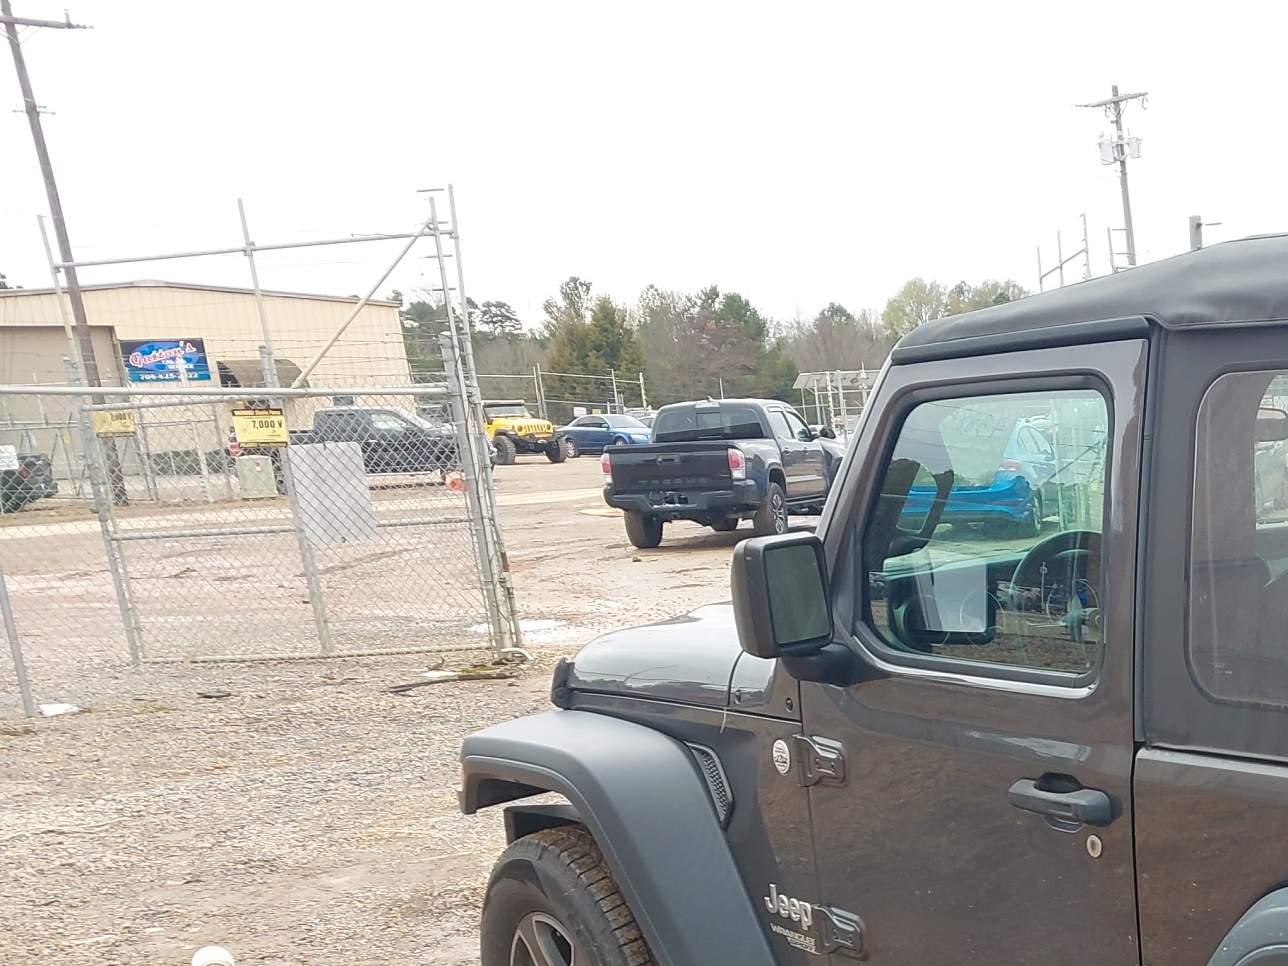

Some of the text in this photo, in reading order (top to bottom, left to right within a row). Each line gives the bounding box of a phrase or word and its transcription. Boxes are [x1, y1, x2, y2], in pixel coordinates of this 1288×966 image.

[251, 420, 282, 430] 7,000 V
[763, 882, 812, 931] Jeep
